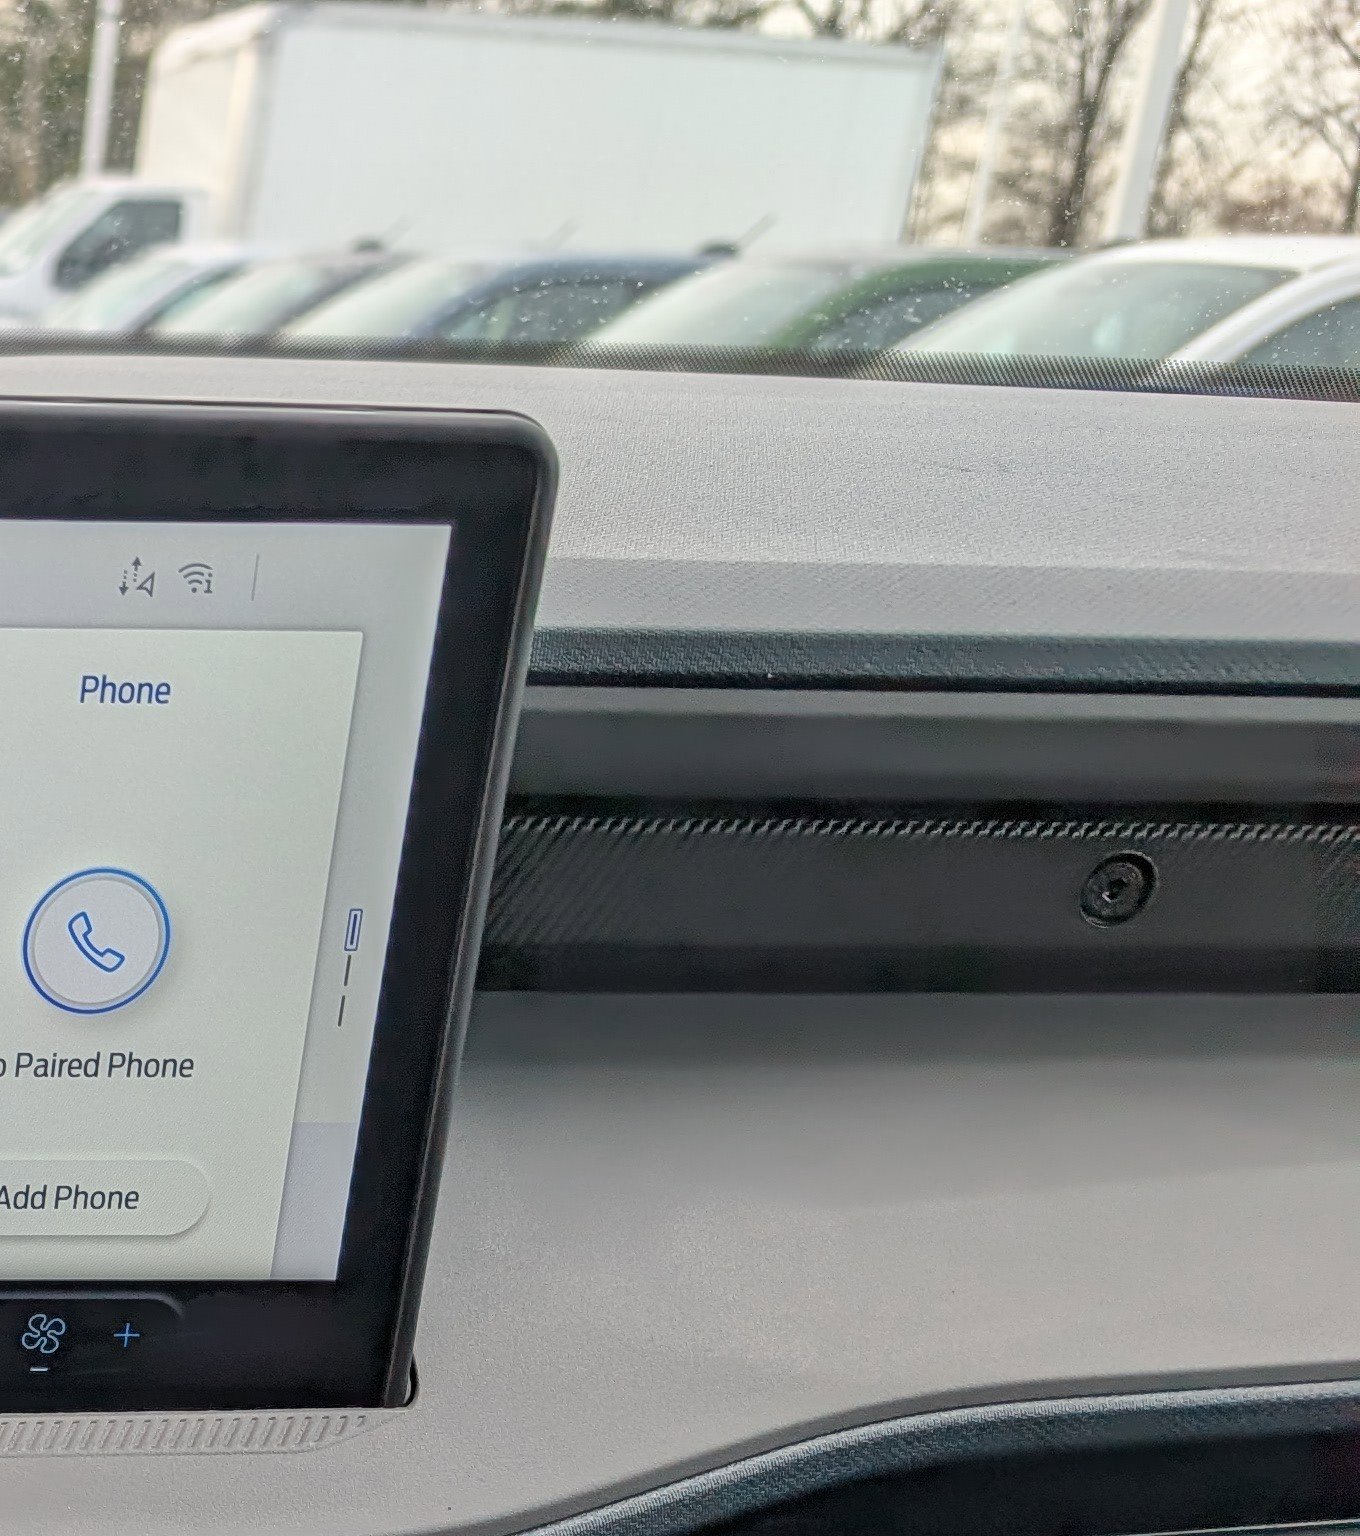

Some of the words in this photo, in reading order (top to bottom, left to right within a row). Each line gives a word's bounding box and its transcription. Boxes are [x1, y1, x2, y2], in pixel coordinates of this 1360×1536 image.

[79, 674, 171, 705] Phone
[14, 1051, 101, 1078] Paired
[107, 1051, 195, 1078] Phone
[53, 1184, 140, 1210] Phone
